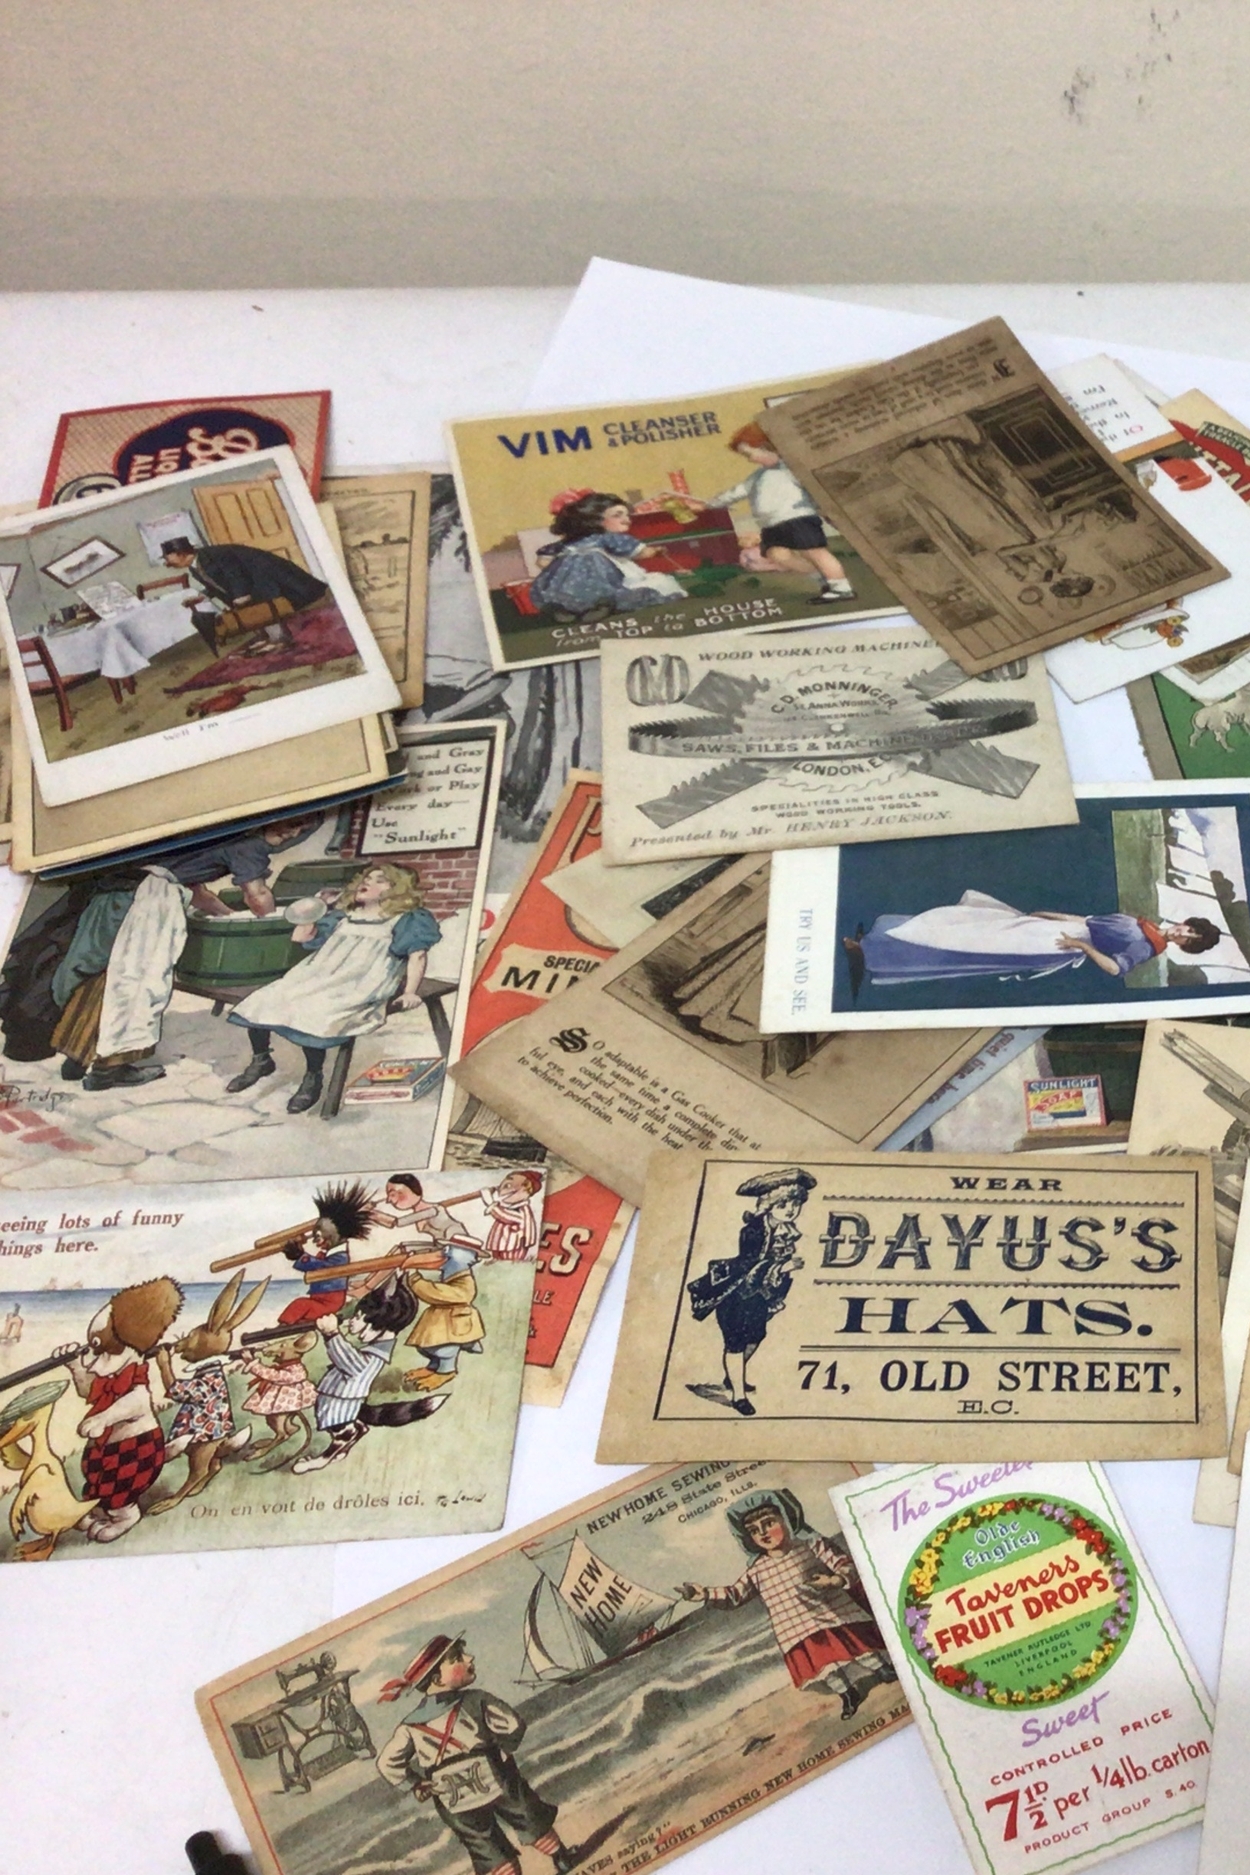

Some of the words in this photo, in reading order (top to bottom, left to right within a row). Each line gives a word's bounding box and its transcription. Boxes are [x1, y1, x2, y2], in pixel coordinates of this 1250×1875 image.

[498, 426, 592, 459] VIM
[603, 411, 718, 436] CLEANSER
[621, 424, 721, 446] POLISHER
[551, 617, 638, 640] CLEANS
[704, 598, 777, 616] HOUSE
[615, 625, 653, 638] TOP
[695, 607, 783, 627] BOTTOM
[698, 650, 753, 662] WOOD
[759, 645, 847, 659] WORKING
[798, 680, 899, 711] MONNINGER
[417, 749, 441, 760] and
[746, 742, 797, 753] FILES
[427, 765, 449, 776] and
[453, 763, 483, 775] Gay
[449, 780, 480, 790] Play
[630, 831, 713, 847] Presented
[719, 830, 740, 841] by
[786, 818, 854, 833] HENRY
[799, 909, 814, 931] TRY
[797, 938, 811, 954] US
[795, 960, 810, 986] AND
[530, 1064, 565, 1092] achieve
[605, 1049, 648, 1081] adaptable
[671, 1090, 691, 1108] Gas
[692, 1103, 726, 1129] Cooker
[1030, 1079, 1096, 1092] SUNLIGHT
[609, 1069, 635, 1088] same
[674, 1109, 718, 1140] complete
[950, 1175, 1064, 1193] WEAR
[58, 1213, 91, 1230] lots
[102, 1211, 122, 1228] of
[131, 1210, 184, 1230] funny
[54, 1236, 99, 1254] here.
[818, 1210, 1183, 1275] DAYUS'S
[834, 1297, 1153, 1337] HATS.
[797, 1360, 852, 1395] 71,
[880, 1360, 970, 1392] OLD
[997, 1361, 1183, 1399] STREET,
[957, 1399, 1021, 1416] E.C.
[190, 1503, 219, 1519] On
[231, 1506, 252, 1517] en
[261, 1500, 296, 1516] voit
[304, 1498, 325, 1513] de
[332, 1493, 390, 1511] drôles
[397, 1492, 425, 1507] ici.
[586, 1512, 623, 1535] NEW
[624, 1488, 666, 1516] HOME
[642, 1501, 678, 1525] 248
[682, 1480, 722, 1504] State
[678, 1495, 728, 1524] CHICAGO,
[881, 1490, 930, 1532] The
[974, 1518, 1020, 1547] Olde
[962, 1528, 1041, 1570] English
[570, 1557, 603, 1610] NEW
[945, 1554, 1080, 1617] Taveners
[584, 1575, 632, 1631] HOME
[934, 1602, 1016, 1654] FRUIT
[1023, 1568, 1109, 1619] DROPS
[984, 1649, 1023, 1668] TAVENER
[1028, 1629, 1071, 1651] RUTLEDGE
[1015, 1640, 1073, 1668] LIVERPOOL
[1019, 1649, 1077, 1677] ENGLAND
[1022, 1691, 1110, 1748] Sweet
[990, 1736, 1104, 1786] CONTROLLED
[1120, 1708, 1172, 1736] PRICE
[1053, 1785, 1090, 1820] per
[1151, 1739, 1210, 1775] carton
[621, 1852, 651, 1873] THE
[654, 1825, 696, 1855] LIGHT
[701, 1788, 761, 1828] RUNNING
[765, 1769, 794, 1792] NEW
[798, 1746, 835, 1772] HOME
[838, 1718, 886, 1750] SEWING
[1024, 1822, 1090, 1854] PRODUCT
[1102, 1798, 1150, 1824] GROUP
